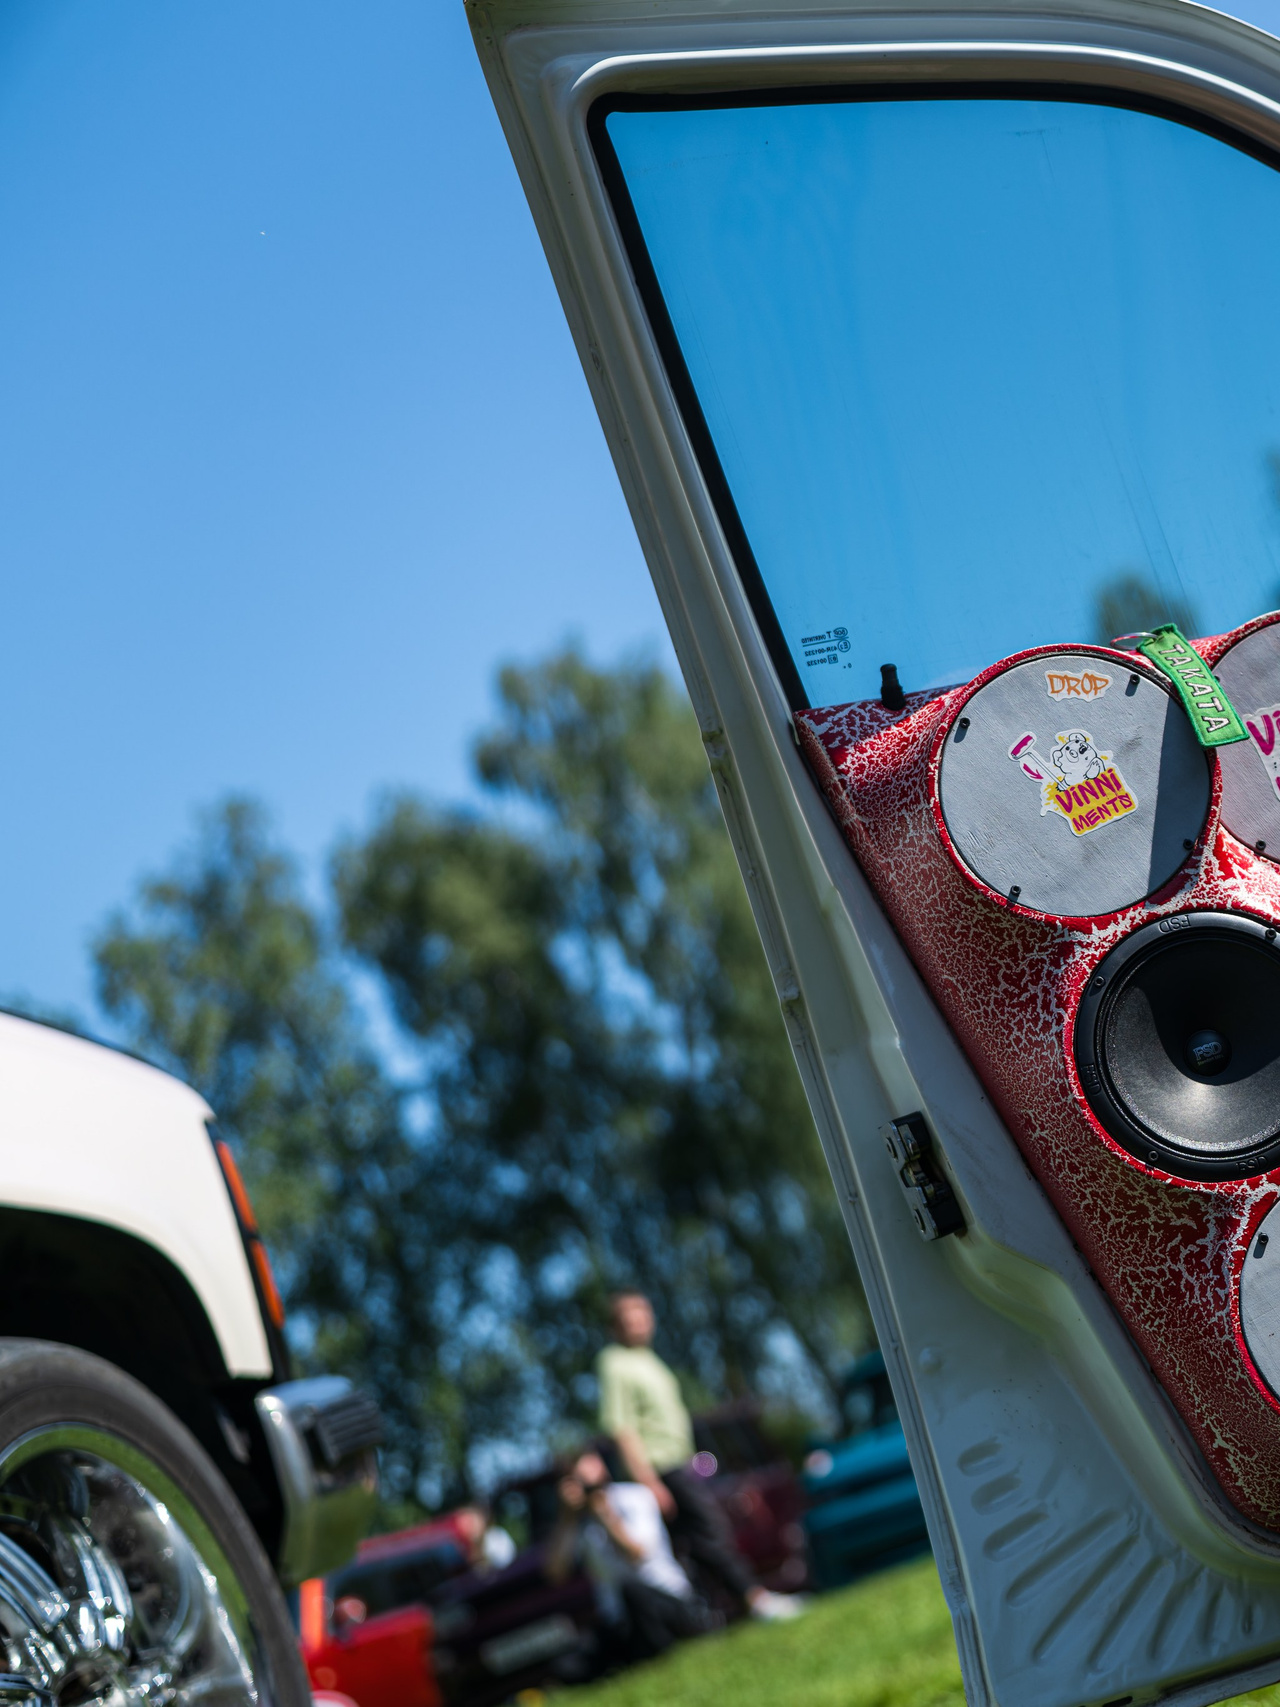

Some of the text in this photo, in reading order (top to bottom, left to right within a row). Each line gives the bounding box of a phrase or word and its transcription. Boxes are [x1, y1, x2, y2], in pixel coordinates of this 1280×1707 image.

[1047, 672, 1109, 696] DROP
[1159, 643, 1231, 733] TAKATA
[1072, 793, 1133, 831] MENTS
[1159, 915, 1191, 933] FSD
[1192, 1041, 1222, 1061] FSD
